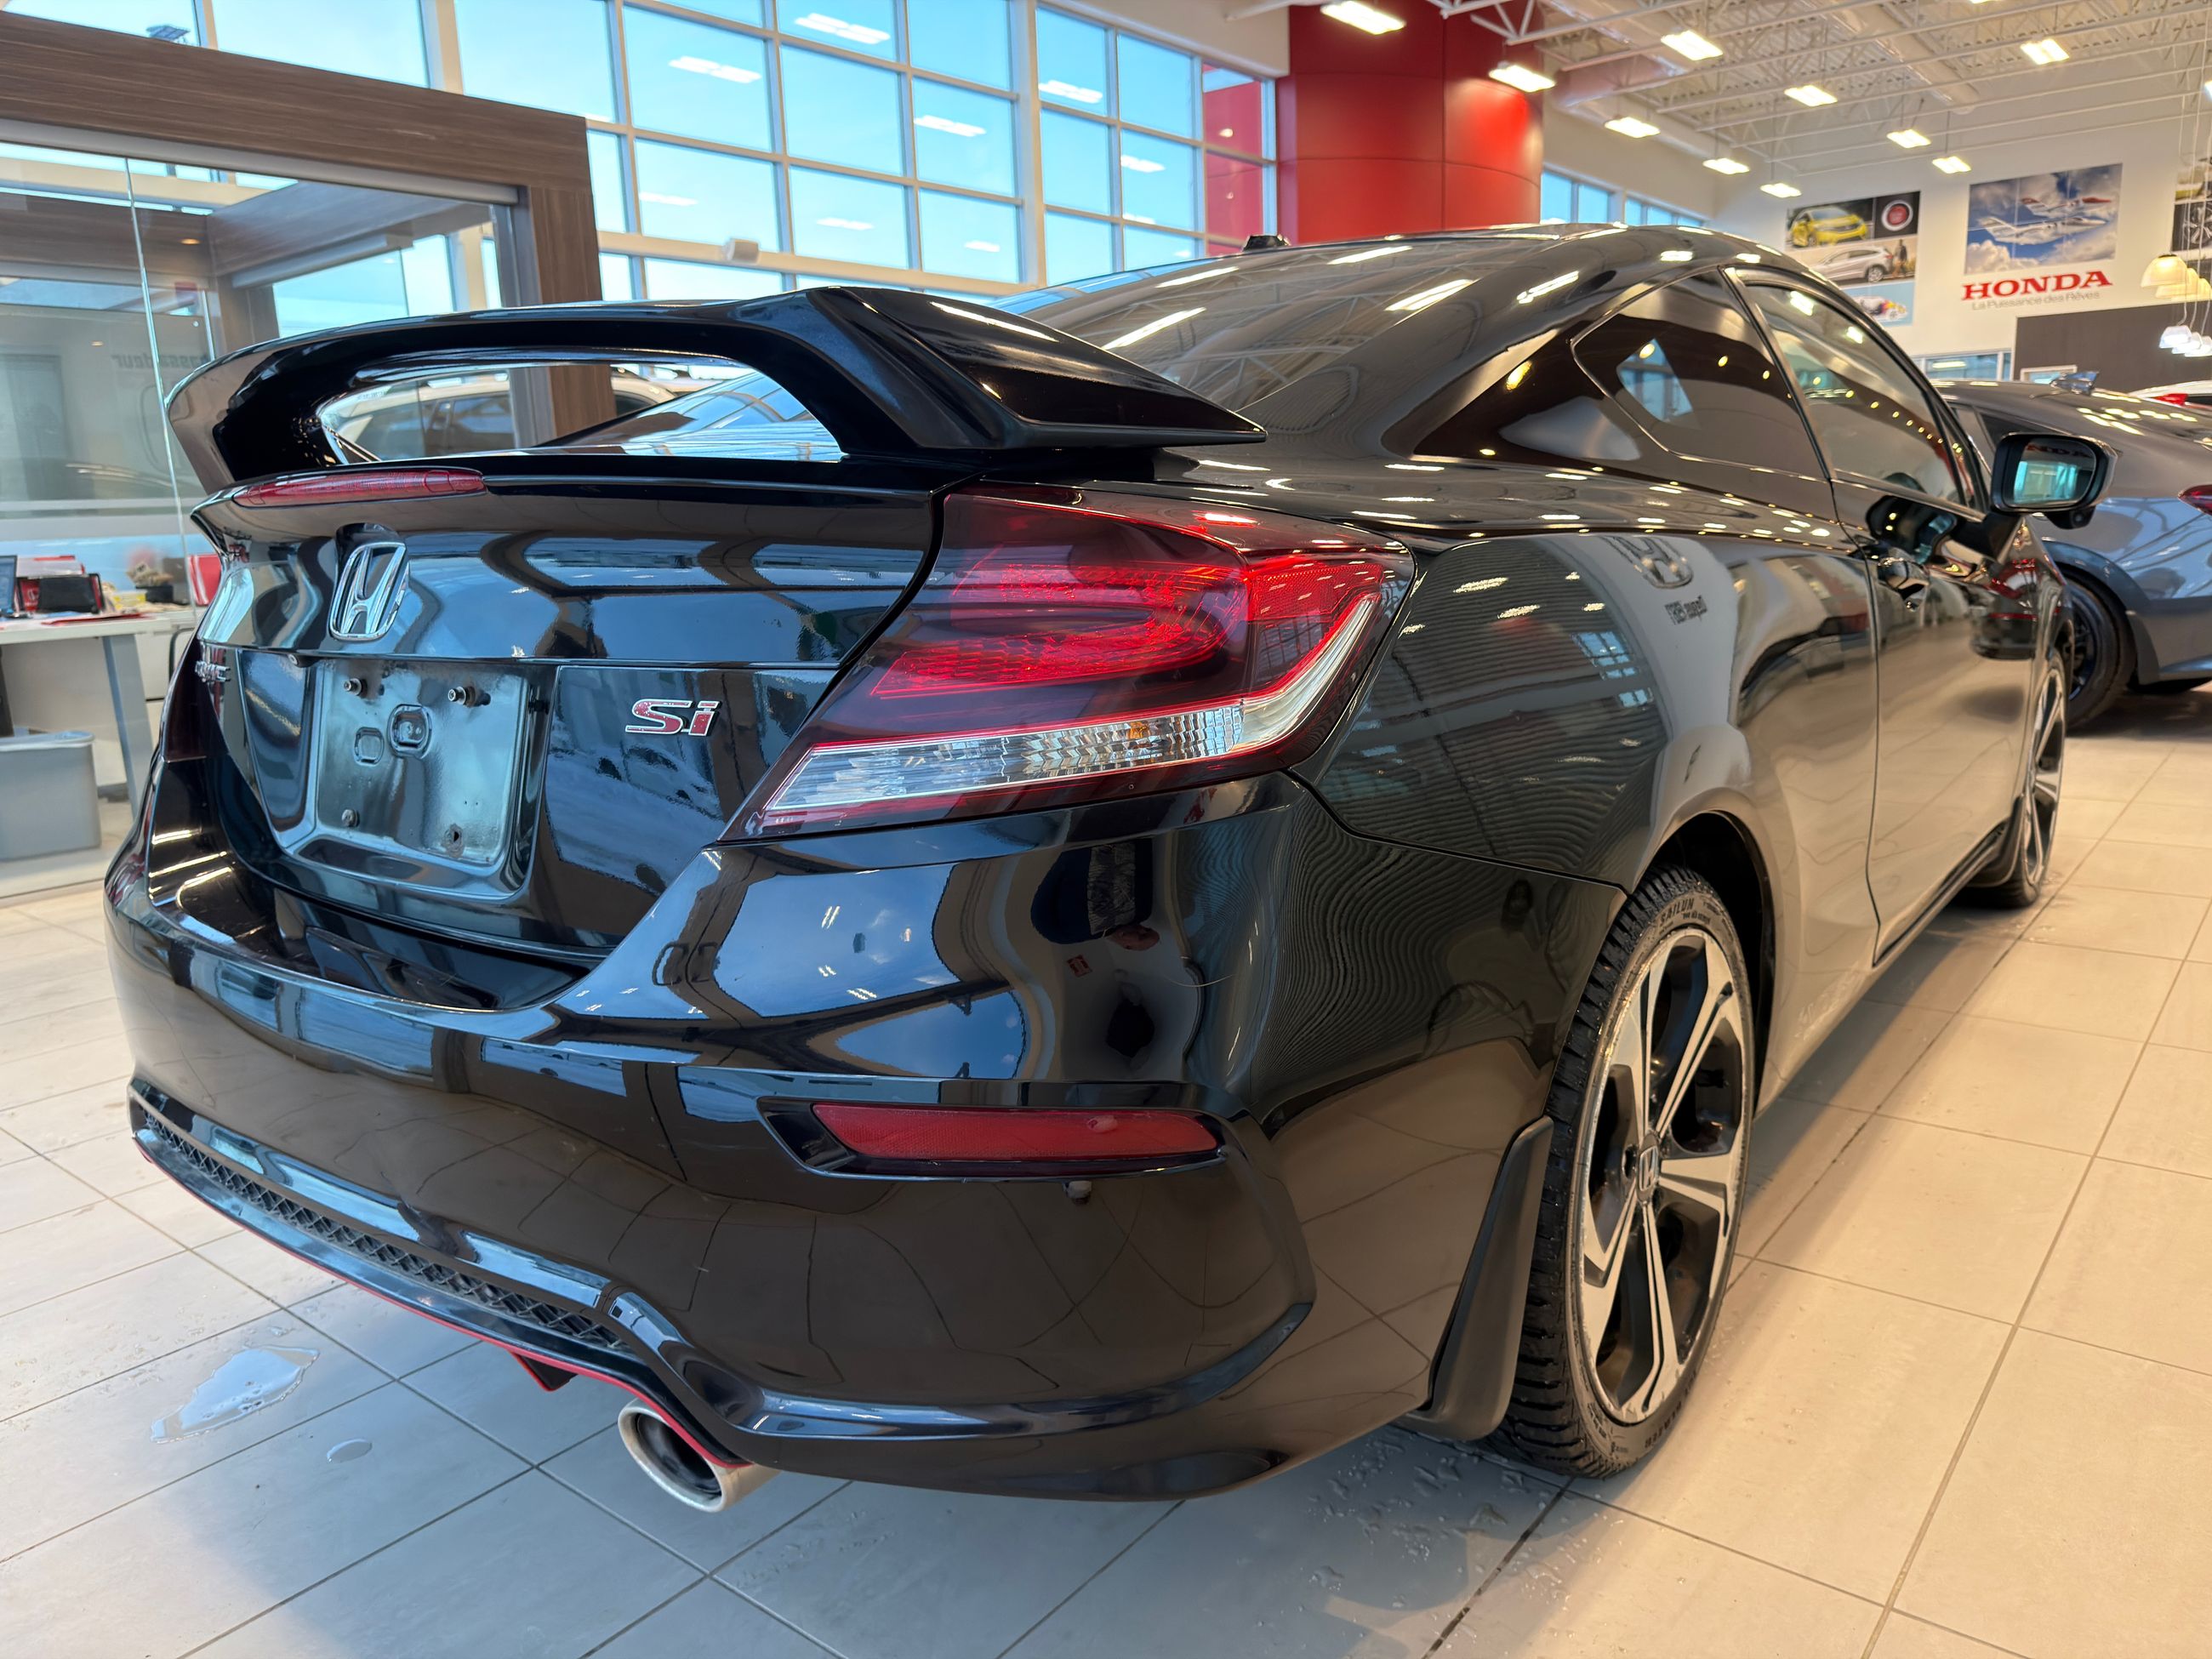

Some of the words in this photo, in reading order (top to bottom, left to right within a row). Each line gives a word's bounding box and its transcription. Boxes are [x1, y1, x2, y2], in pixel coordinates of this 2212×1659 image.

[1961, 271, 2112, 300] HONDA
[1972, 302, 1987, 311] La
[1987, 297, 2041, 309] Puissance
[2044, 293, 2064, 304] des
[625, 698, 720, 736] Si
